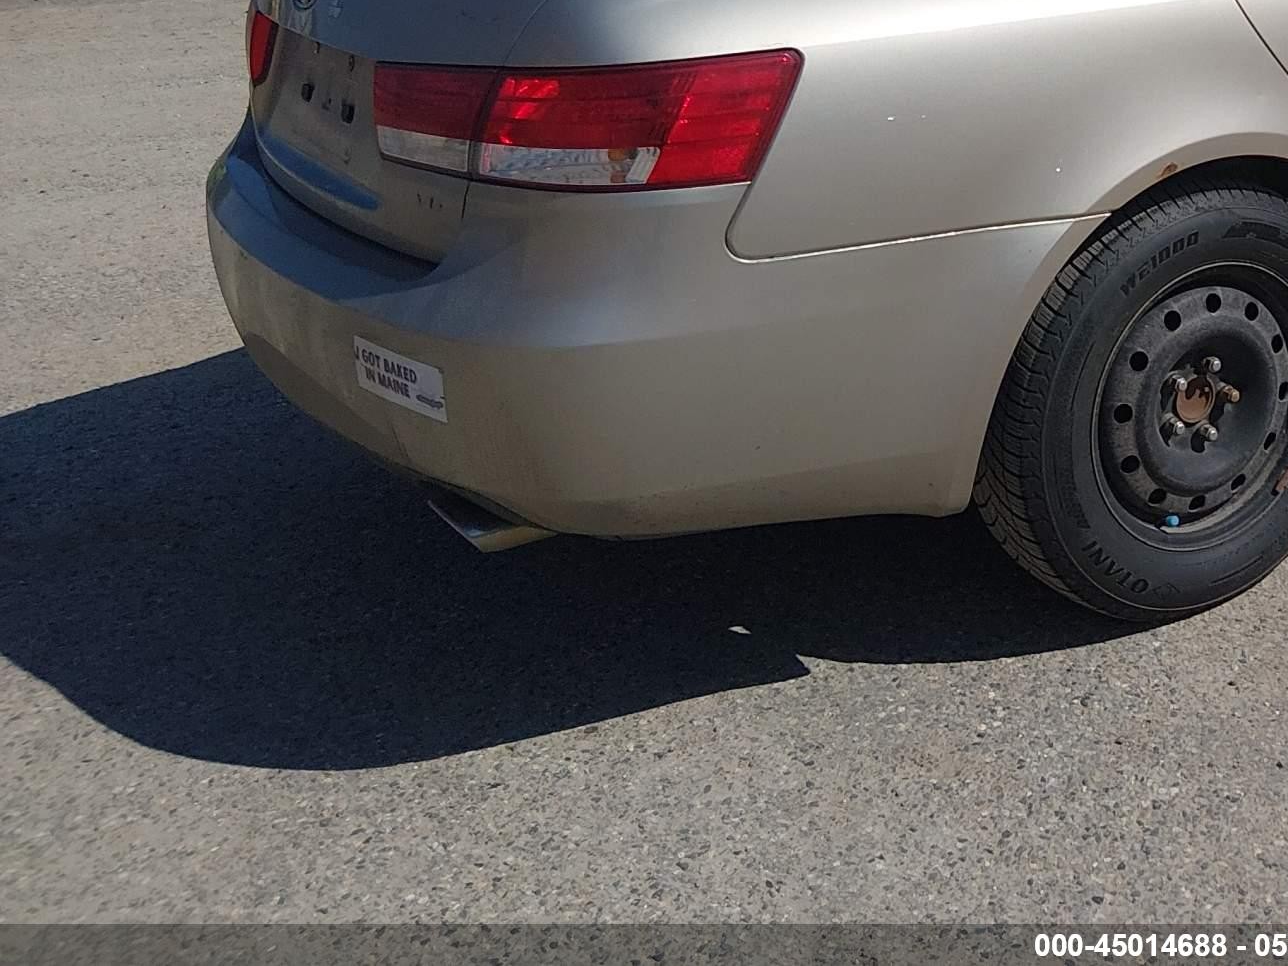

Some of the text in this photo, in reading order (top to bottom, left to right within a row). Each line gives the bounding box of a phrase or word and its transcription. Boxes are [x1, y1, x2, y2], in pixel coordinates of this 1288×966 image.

[361, 348, 380, 369] GOT
[383, 358, 417, 384] BAKED
[377, 372, 411, 399] MAINE
